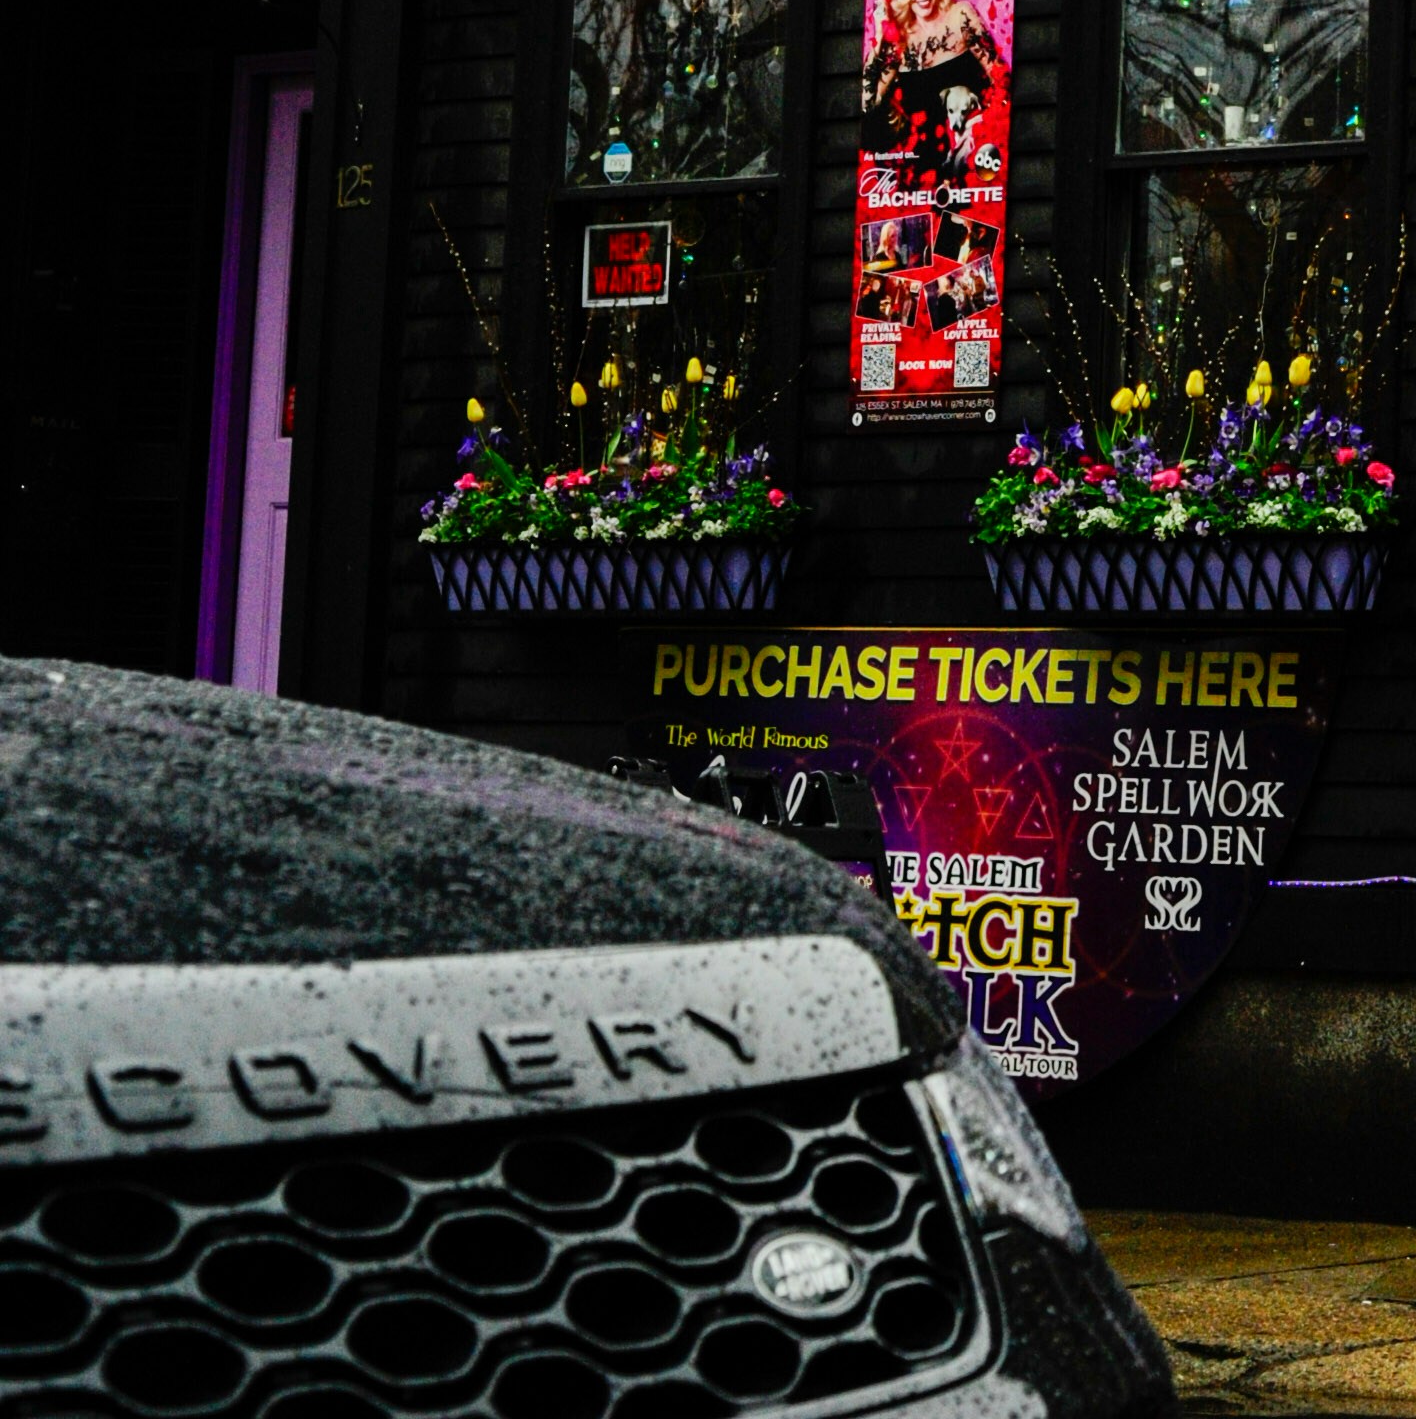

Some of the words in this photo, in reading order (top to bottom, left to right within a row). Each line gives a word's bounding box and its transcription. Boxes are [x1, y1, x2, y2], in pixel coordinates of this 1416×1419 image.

[974, 151, 1002, 172] abc
[336, 164, 374, 209] 125
[859, 167, 898, 197] The
[868, 184, 1003, 209] BACHELORETTE
[608, 230, 651, 261] HELP
[594, 262, 664, 295] WANTED
[862, 322, 901, 333] PRIVATE
[944, 330, 968, 340] LOVE
[972, 329, 999, 339] SPELL
[957, 319, 987, 329] APPLE
[860, 332, 902, 343] READING
[899, 360, 925, 371] BOOK
[929, 360, 953, 370] NOW
[930, 400, 943, 408] MA
[652, 644, 917, 703] PURCHASE
[928, 646, 1142, 707] TICKETS
[1155, 650, 1299, 708] HERE
[666, 725, 697, 747] The
[706, 726, 757, 749] World
[762, 726, 829, 750] Famous
[1112, 728, 1248, 770] SALEM
[1087, 821, 1265, 871] GARDEN
[929, 856, 1042, 890] SALEM
[1027, 1058, 1076, 1076] TOUR
